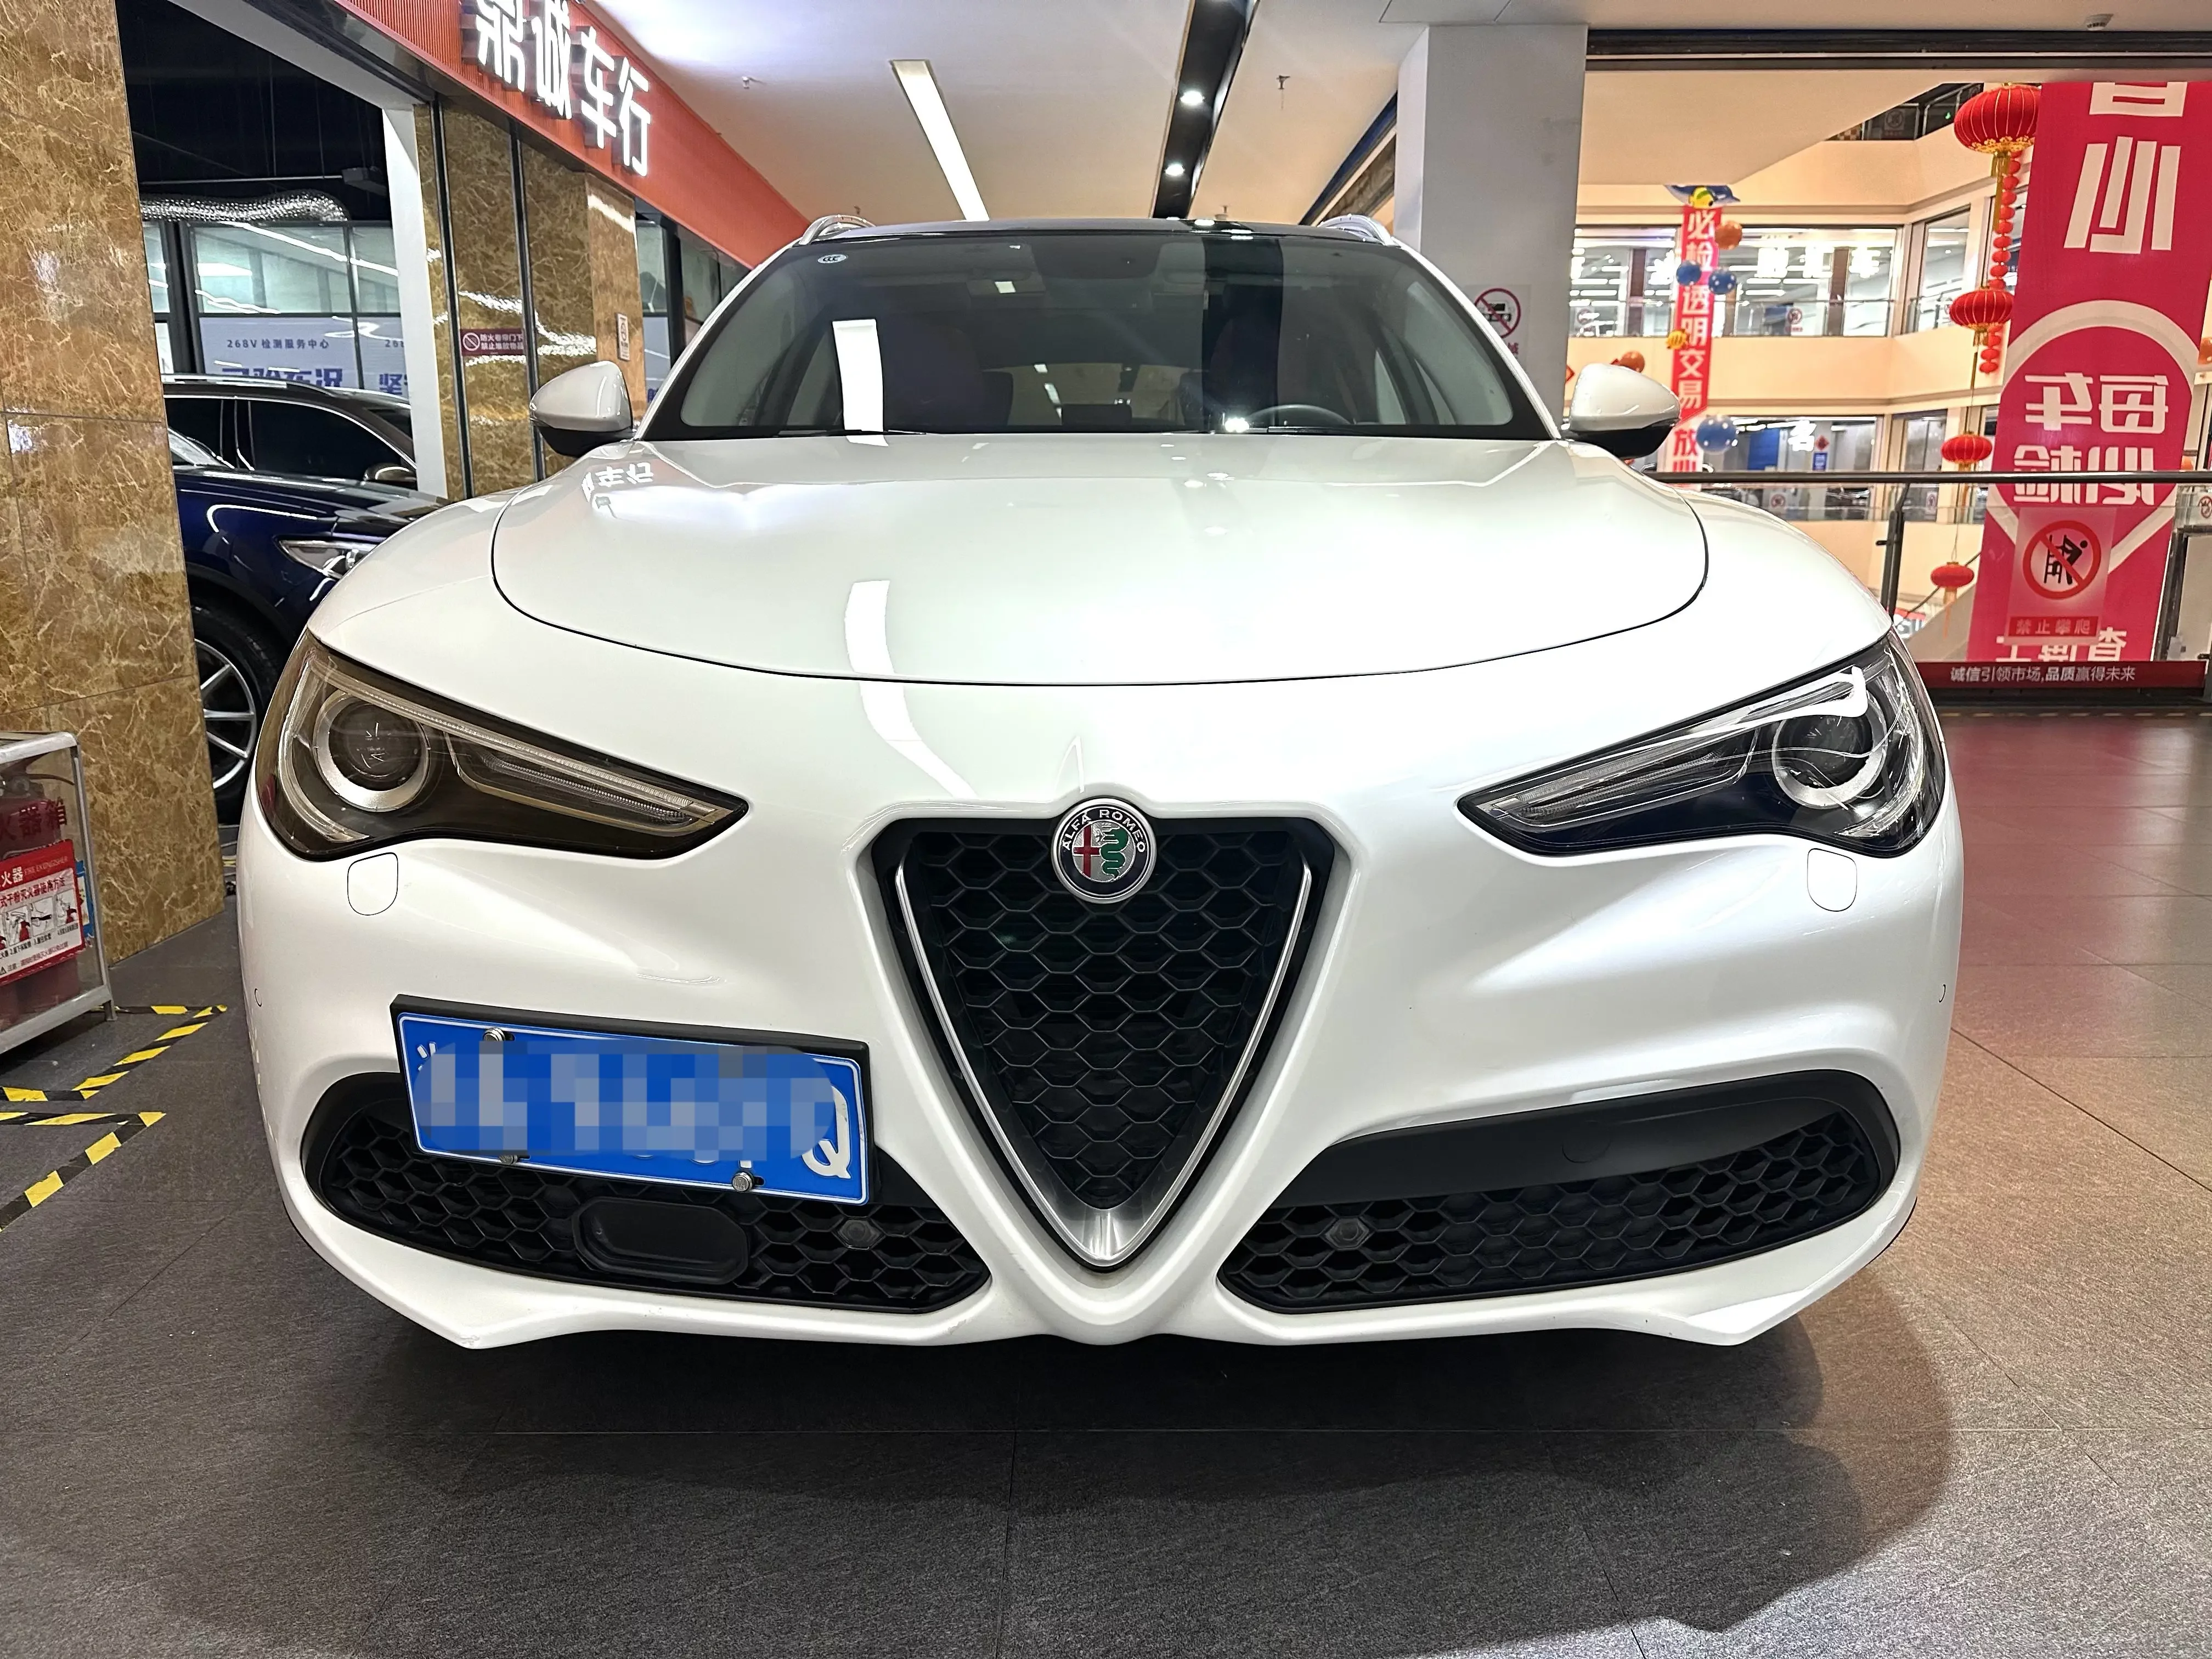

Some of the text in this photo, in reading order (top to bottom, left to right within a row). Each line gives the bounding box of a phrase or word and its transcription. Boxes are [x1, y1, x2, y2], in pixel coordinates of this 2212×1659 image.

[227, 338, 330, 349] 268V 检测服务中心
[379, 374, 408, 395] 坚
[2016, 619, 2090, 635] 禁止攀爬
[1061, 809, 1146, 853] ALFA ROMEO
